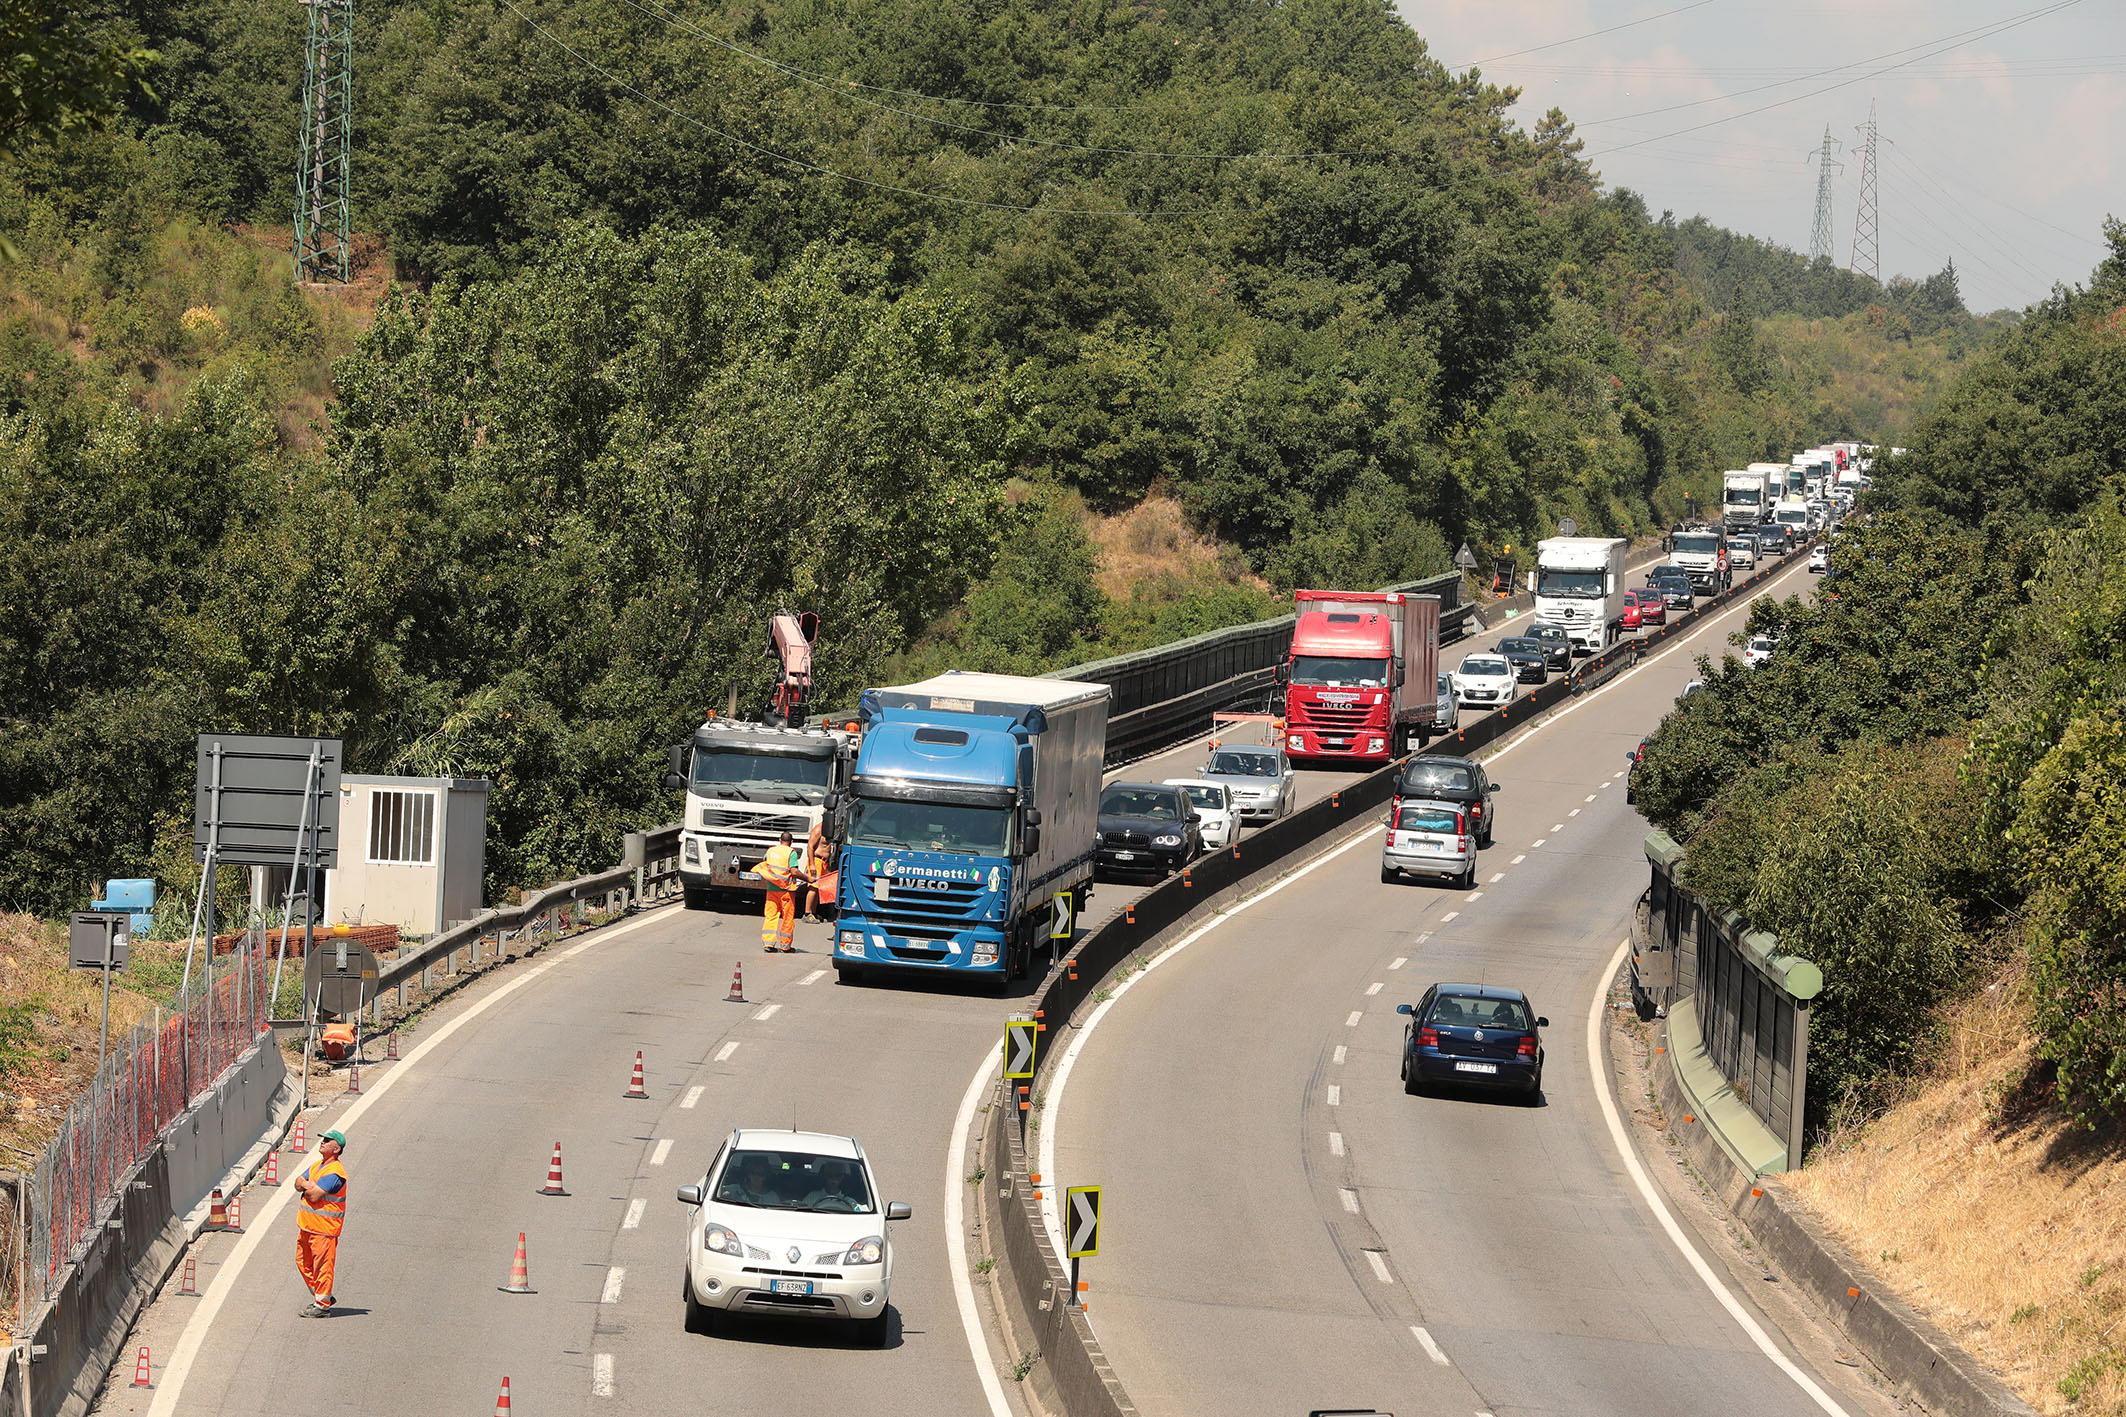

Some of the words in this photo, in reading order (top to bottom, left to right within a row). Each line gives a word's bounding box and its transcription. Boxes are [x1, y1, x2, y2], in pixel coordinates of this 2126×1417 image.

[1322, 702, 1353, 710] IVECO
[882, 858, 968, 880] Germanetti
[898, 877, 949, 891] IVECO
[777, 1282, 785, 1291] EF
